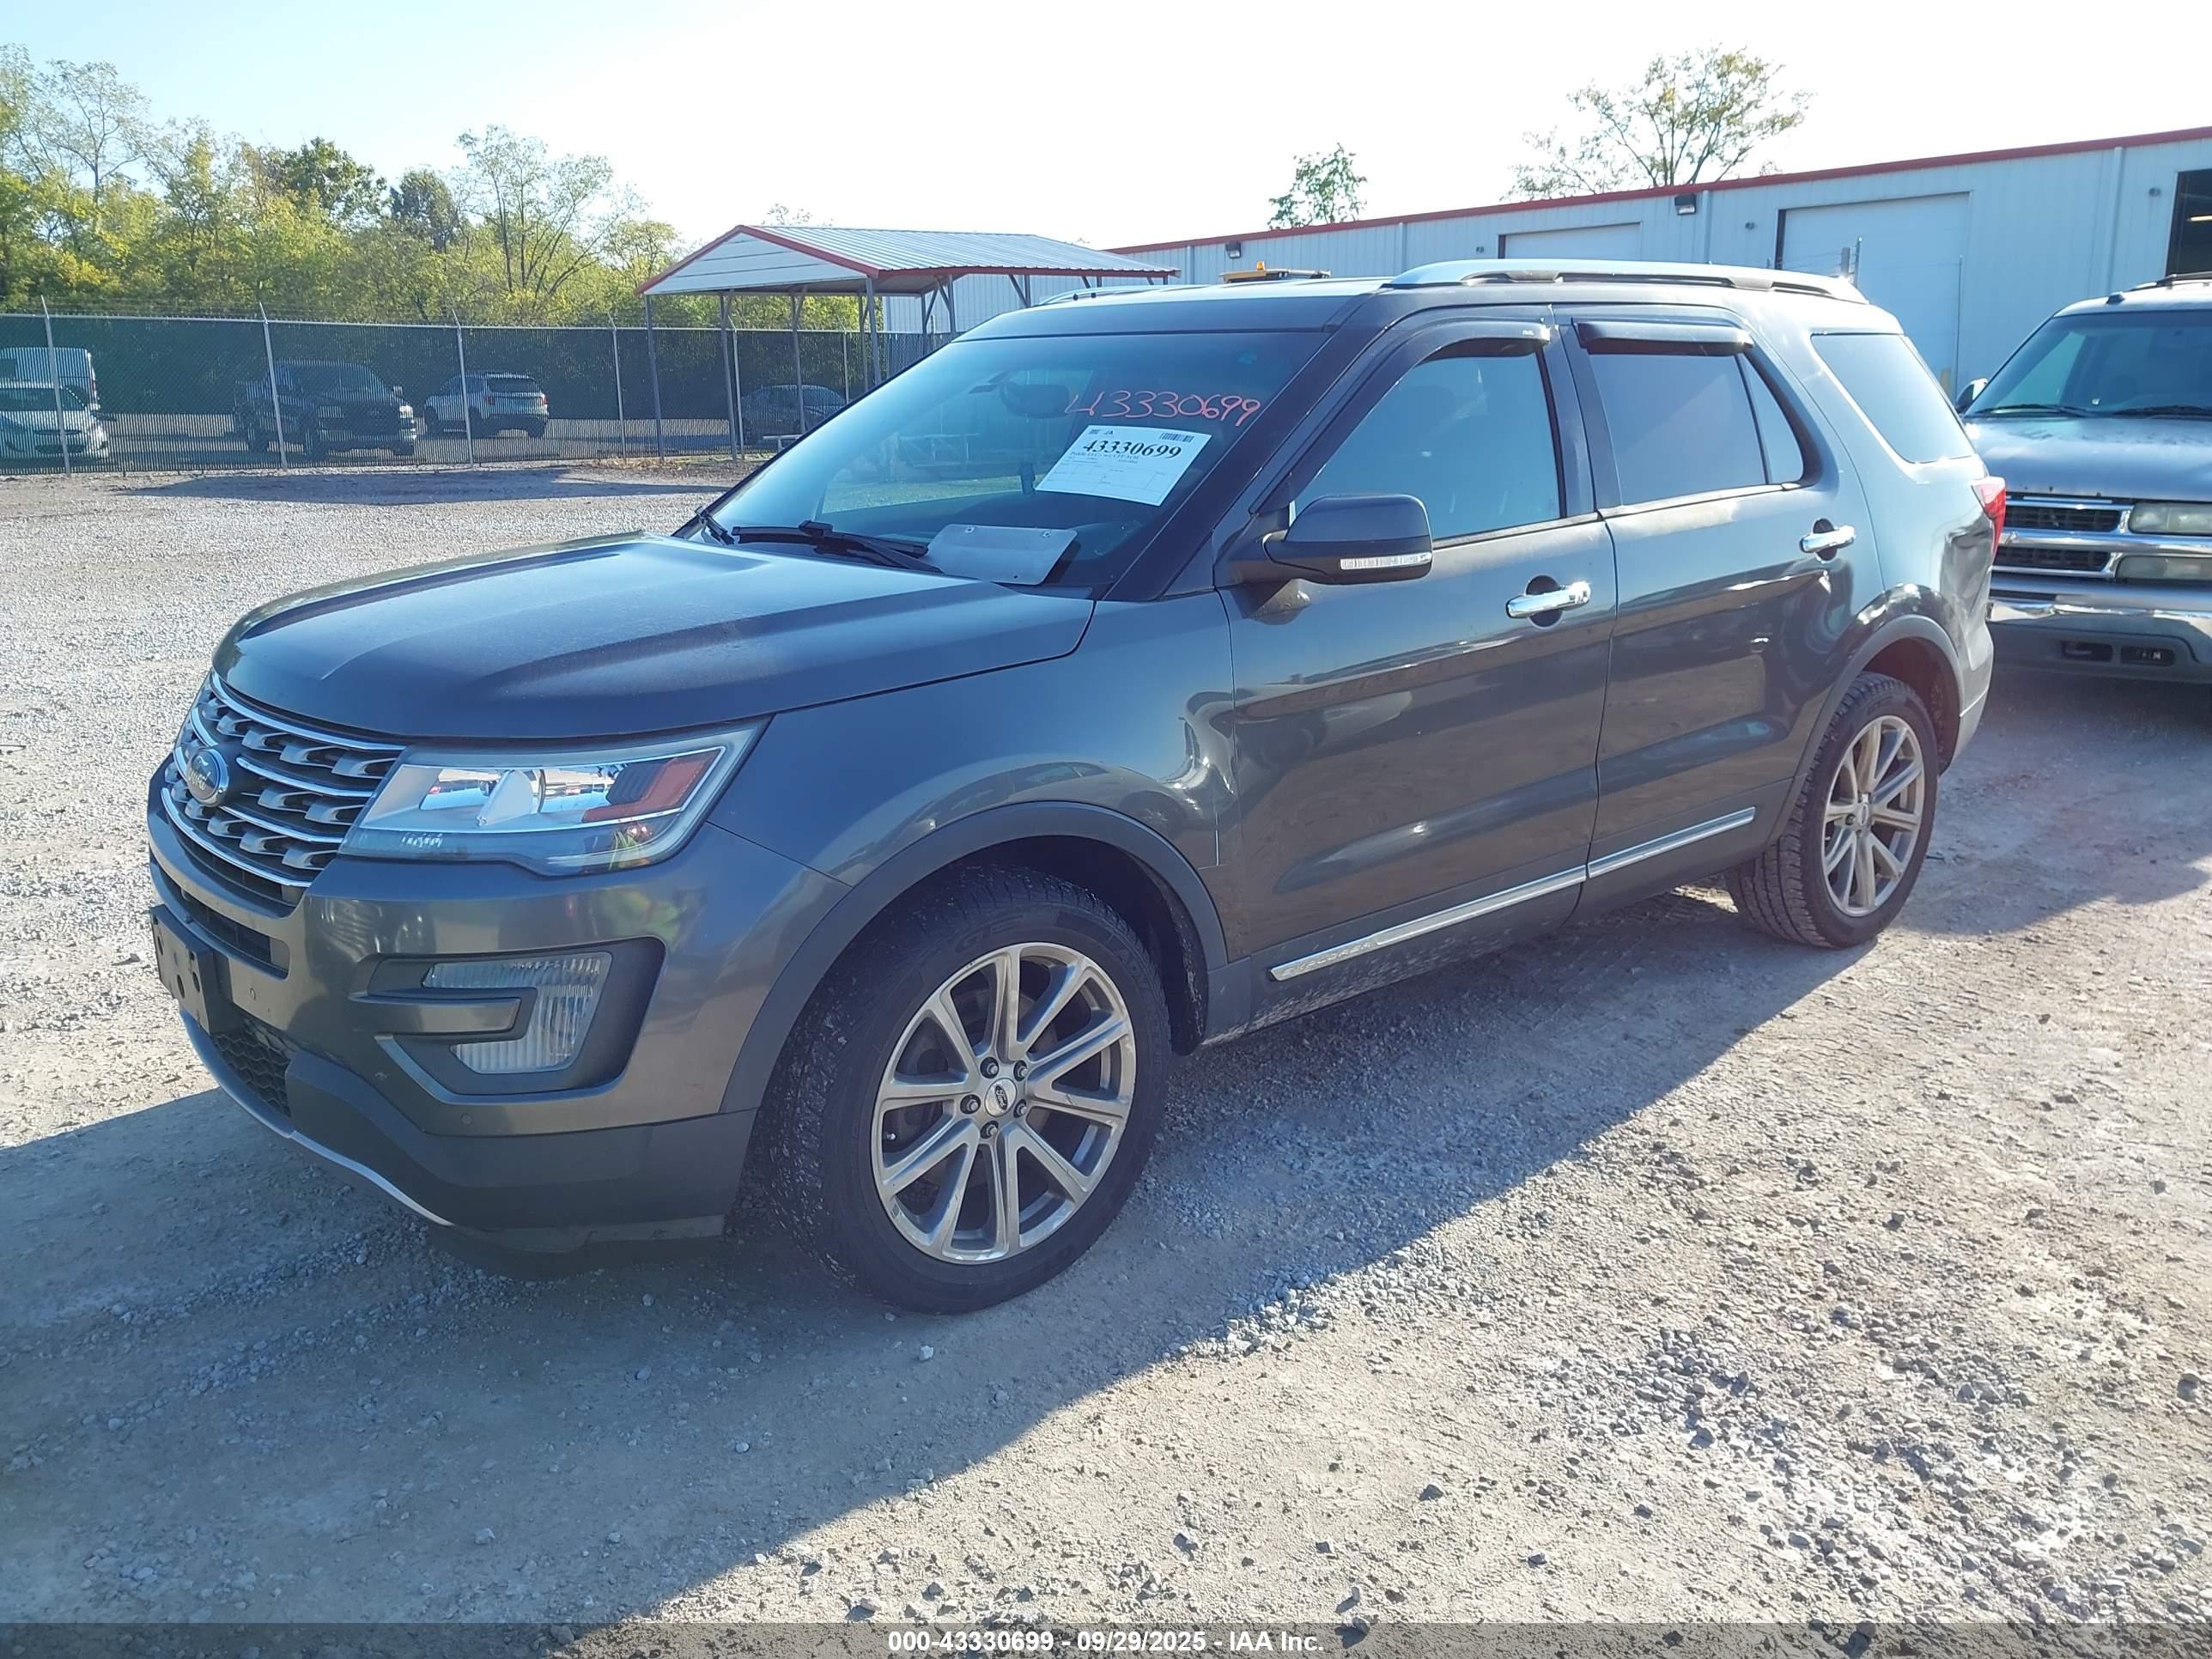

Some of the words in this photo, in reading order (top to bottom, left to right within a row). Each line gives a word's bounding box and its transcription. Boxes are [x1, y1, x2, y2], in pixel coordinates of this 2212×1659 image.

[1064, 390, 1262, 427] 43330699
[1082, 439, 1182, 459] 43330699
[995, 1087, 1007, 1109] Ford
